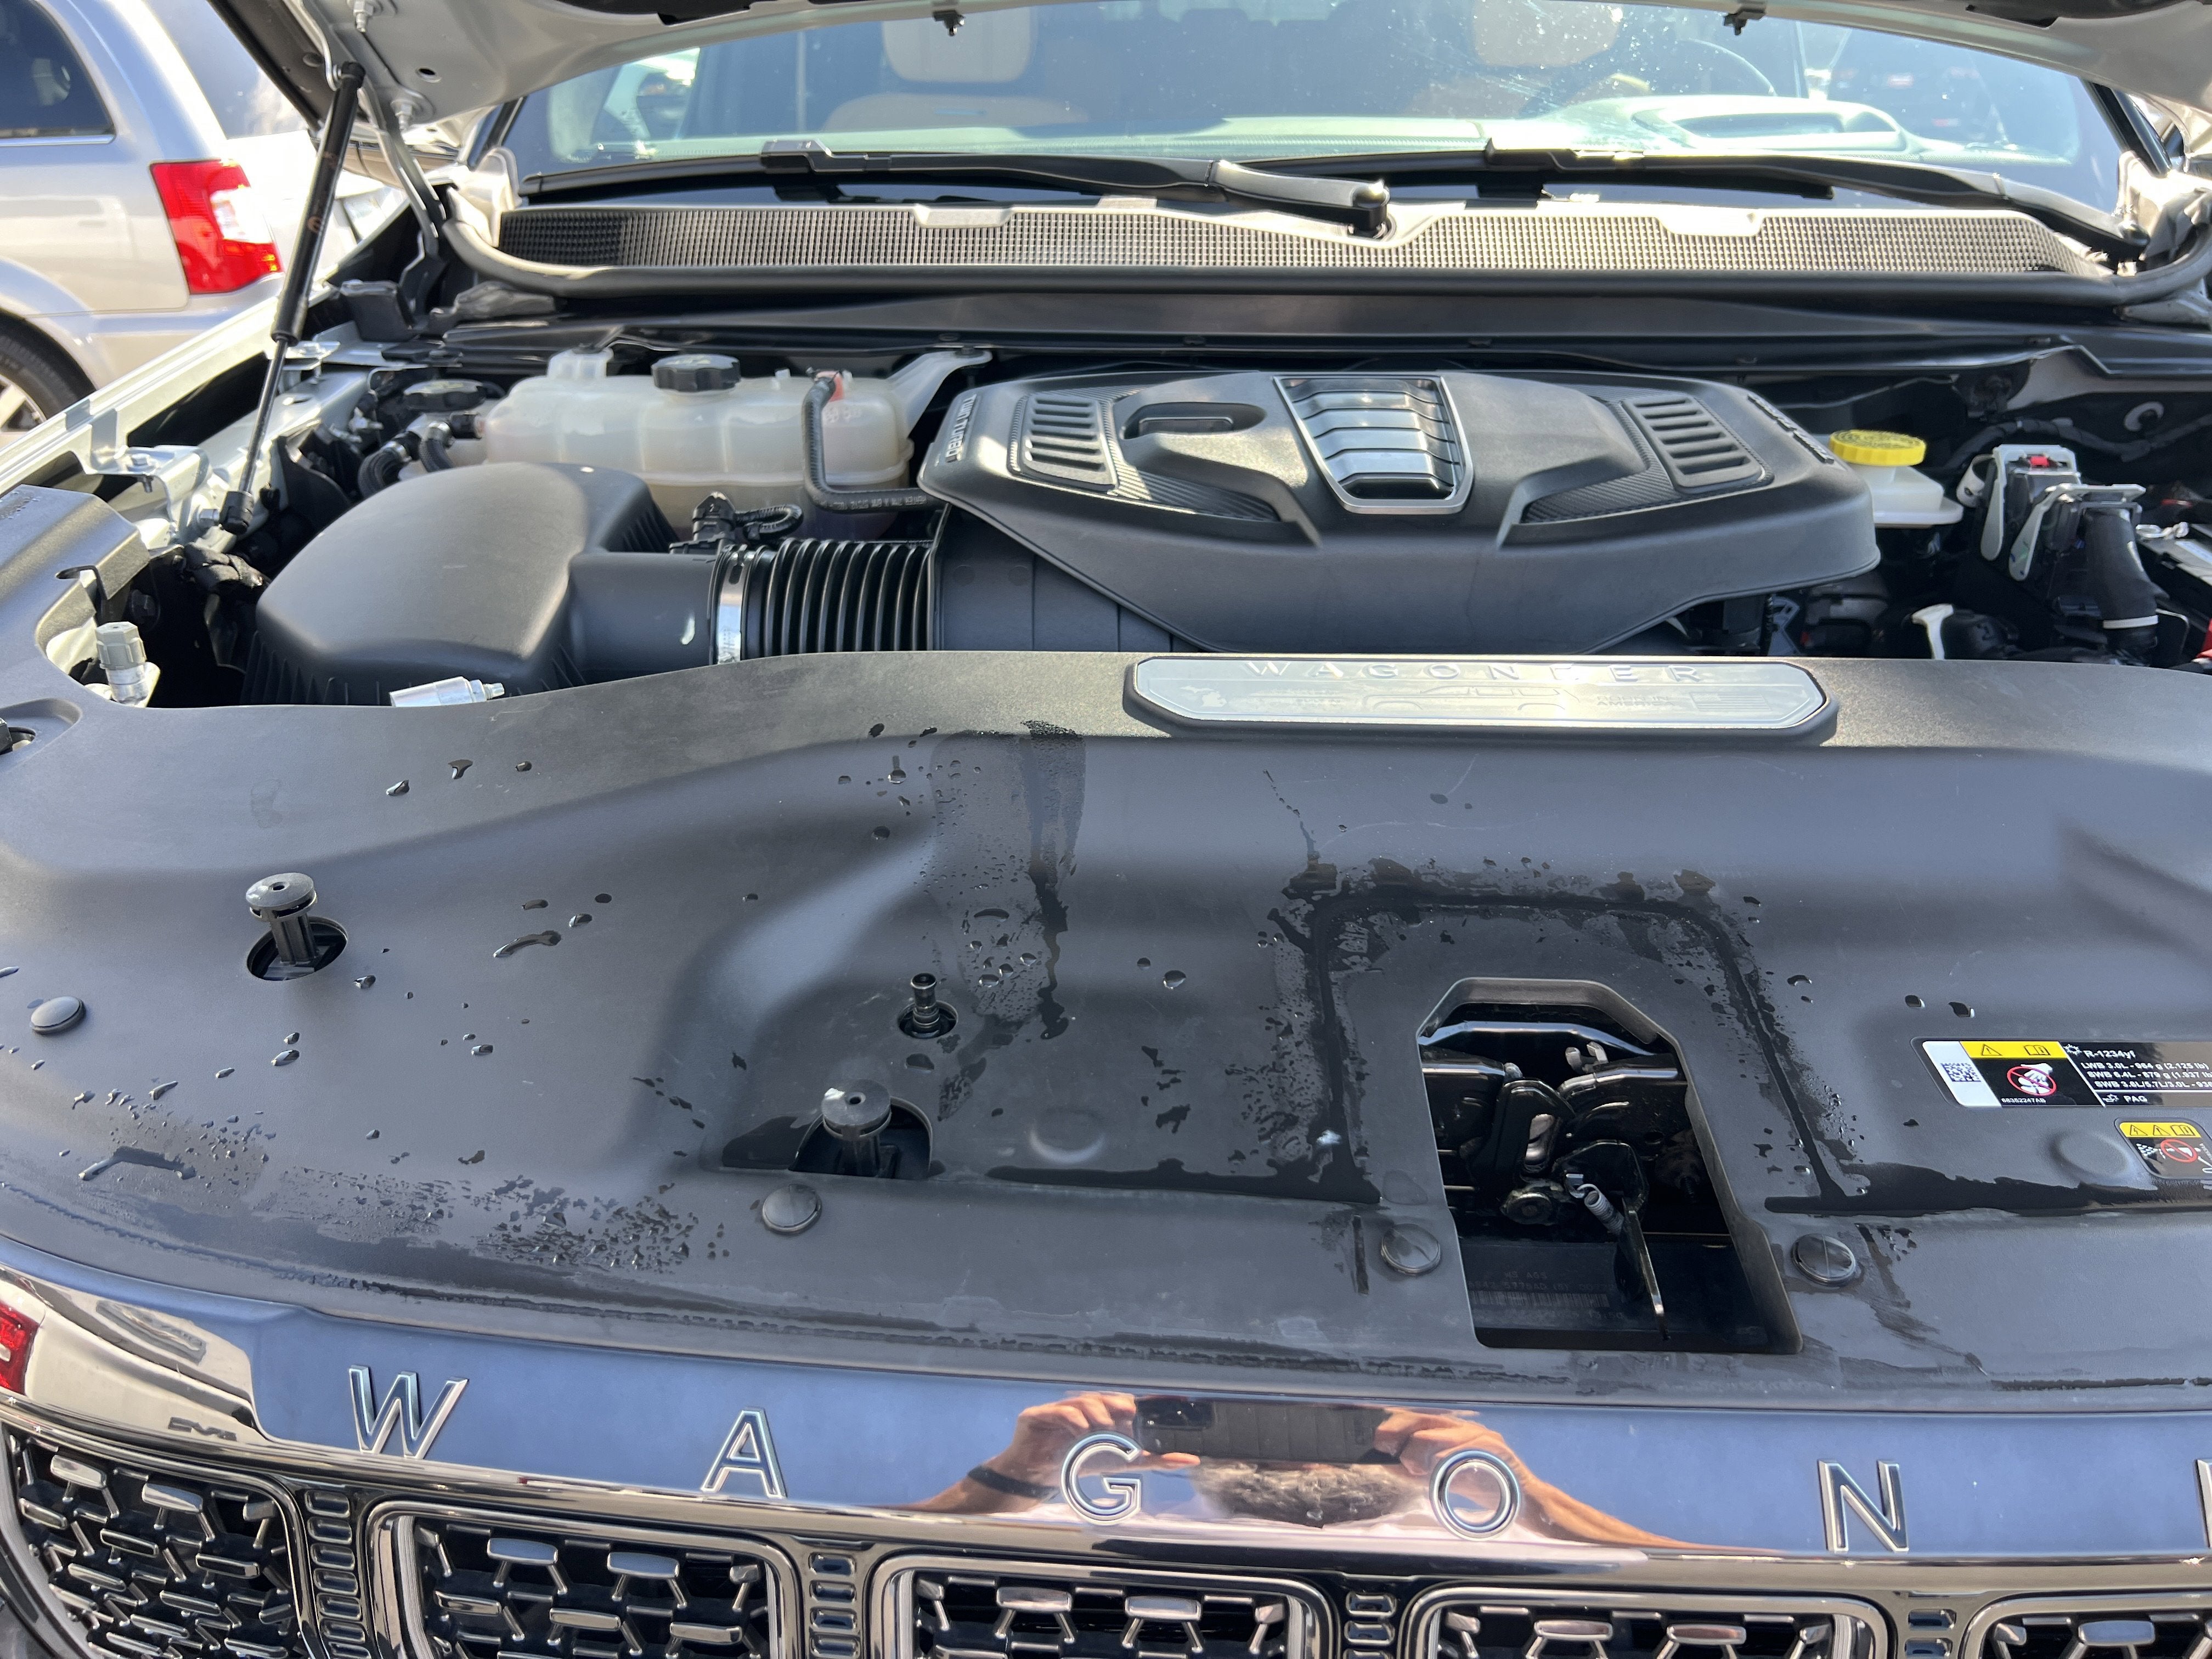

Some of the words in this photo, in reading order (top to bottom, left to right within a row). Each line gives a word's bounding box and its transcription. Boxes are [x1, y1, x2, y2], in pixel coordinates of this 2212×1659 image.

[945, 419, 968, 458] TURBO
[2083, 1050, 2136, 1059] R-1234yf
[2123, 1094, 2148, 1103] PAG
